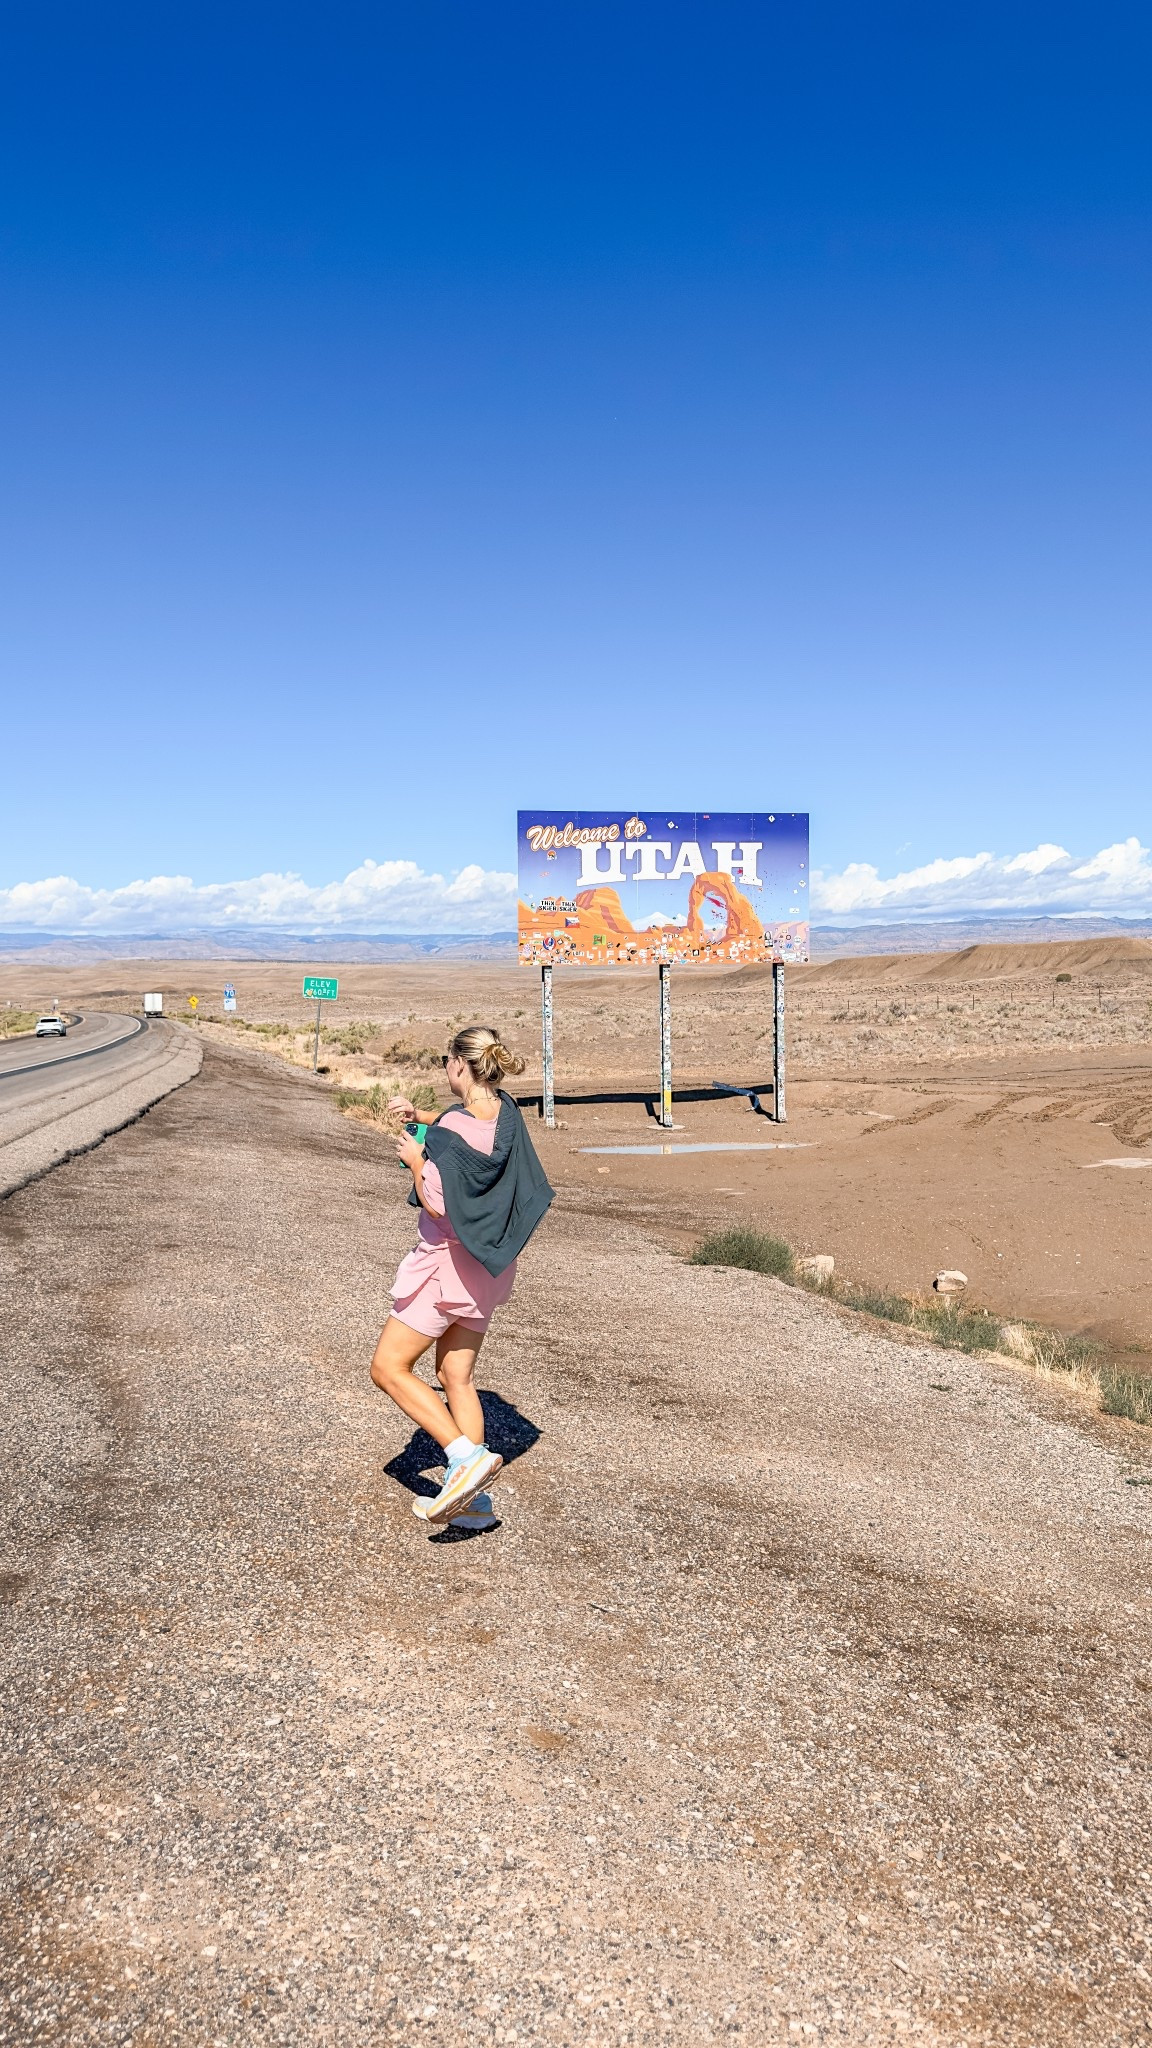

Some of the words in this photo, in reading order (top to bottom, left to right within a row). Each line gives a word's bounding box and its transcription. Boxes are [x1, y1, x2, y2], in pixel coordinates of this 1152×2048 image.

[527, 822, 620, 851] Welcome
[625, 817, 647, 839] to
[576, 842, 763, 886] UTAH
[310, 980, 331, 988] ELEV
